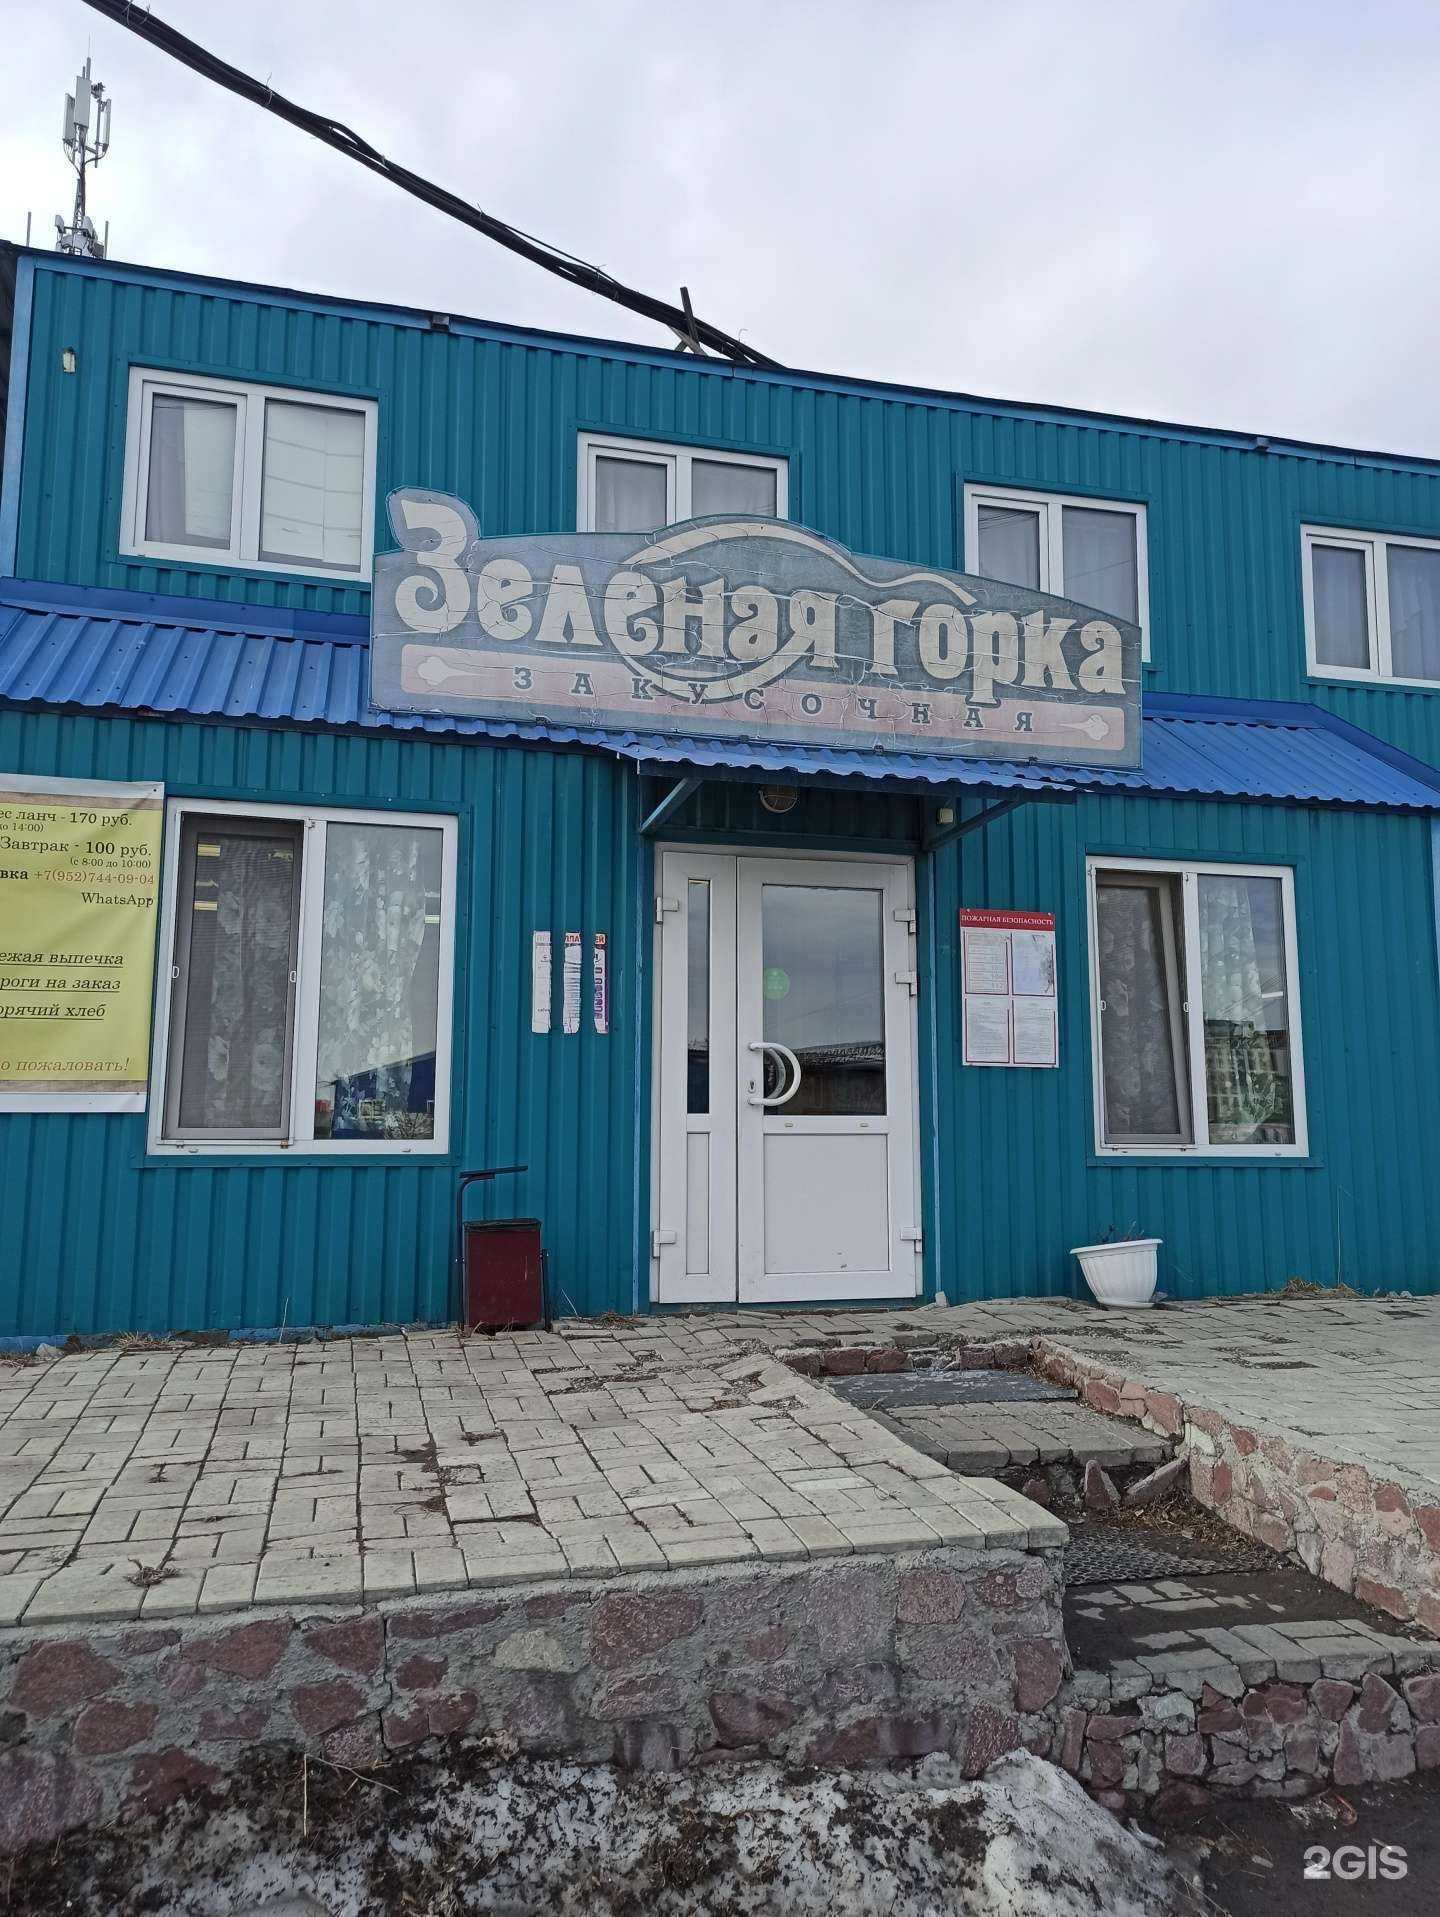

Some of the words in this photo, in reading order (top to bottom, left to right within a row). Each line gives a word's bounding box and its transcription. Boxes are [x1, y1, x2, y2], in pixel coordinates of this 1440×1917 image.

[395, 499, 839, 669] Зеленая
[512, 666, 1033, 732] ЗАКУСОЧНАЯ
[16, 810, 56, 823] ланч
[70, 811, 97, 824] 170
[101, 813, 133, 828] руб.
[1, 835, 69, 854] Завтрак
[86, 841, 115, 855] 100
[120, 843, 152, 859] руб.
[82, 857, 104, 867] 8:00
[121, 859, 151, 869] 10:00)
[0, 869, 29, 880] вка
[81, 892, 154, 908] WhatsApp
[961, 914, 1001, 923] ПОЖАРНАЯ
[1002, 917, 1054, 926] БЕЗОПАСНОСТЬ
[0, 952, 43, 963] ежая
[50, 953, 124, 965] выпечка
[0, 976, 40, 990] роги
[46, 979, 66, 989] на
[72, 979, 121, 990] заказ
[64, 1003, 107, 1017] хлеб
[0, 1060, 11, 1071] о
[16, 1056, 130, 1071] пожаловать!
